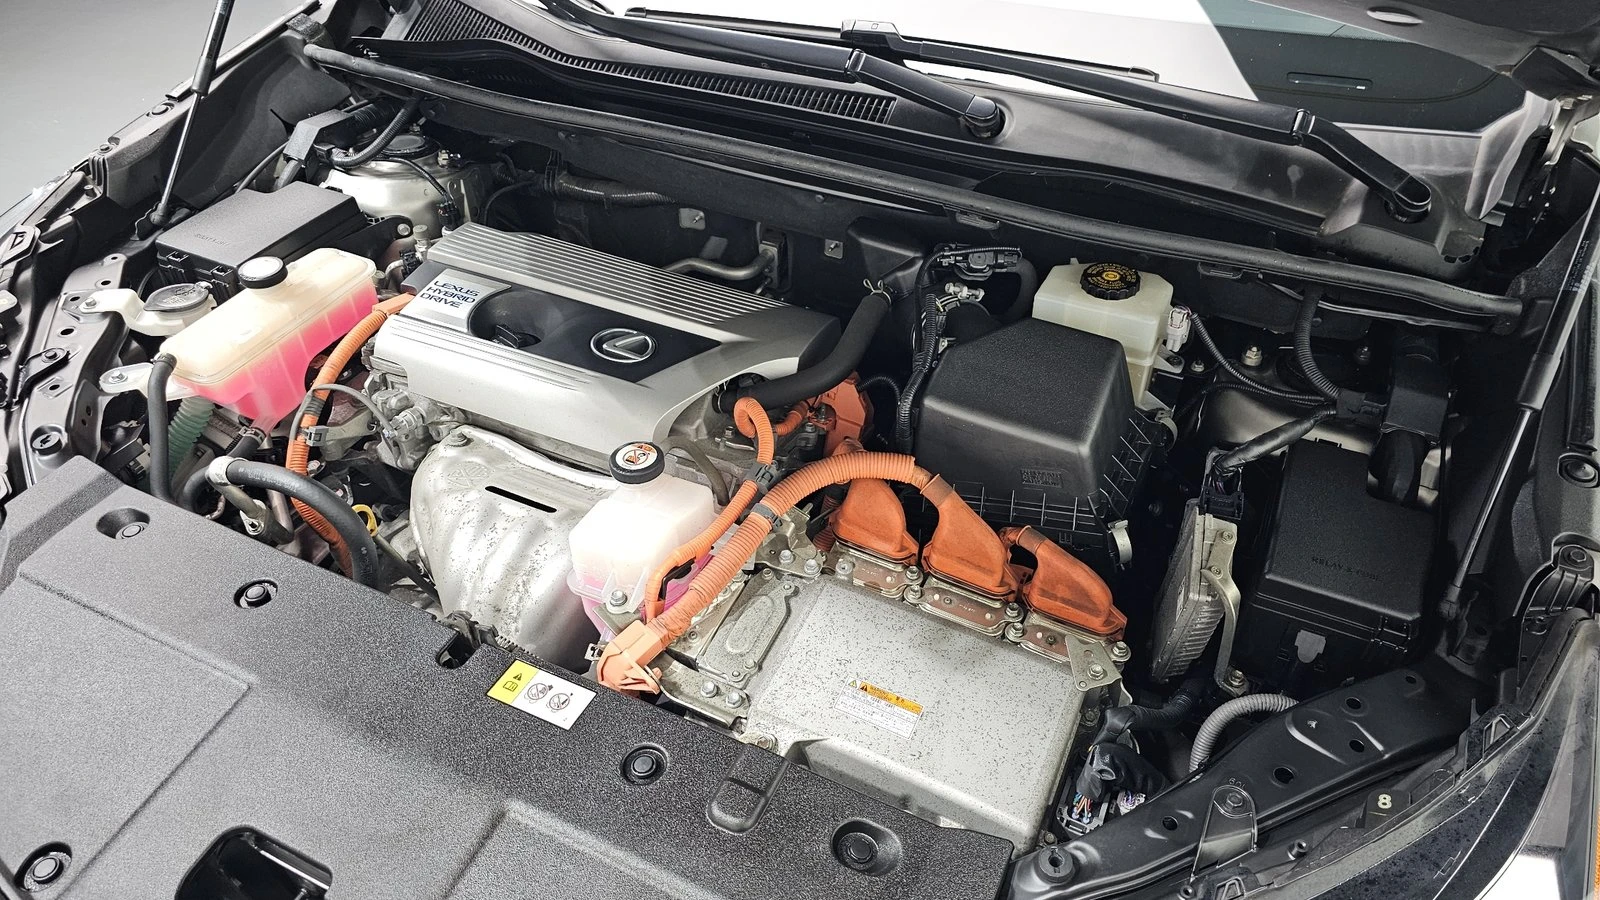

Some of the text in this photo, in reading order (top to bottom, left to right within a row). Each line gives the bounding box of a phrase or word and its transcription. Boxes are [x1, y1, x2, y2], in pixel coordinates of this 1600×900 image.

[426, 286, 476, 304] HYBRID
[433, 280, 480, 297] LEXUS
[419, 292, 463, 309] DRIVE
[1377, 793, 1393, 809] 8
